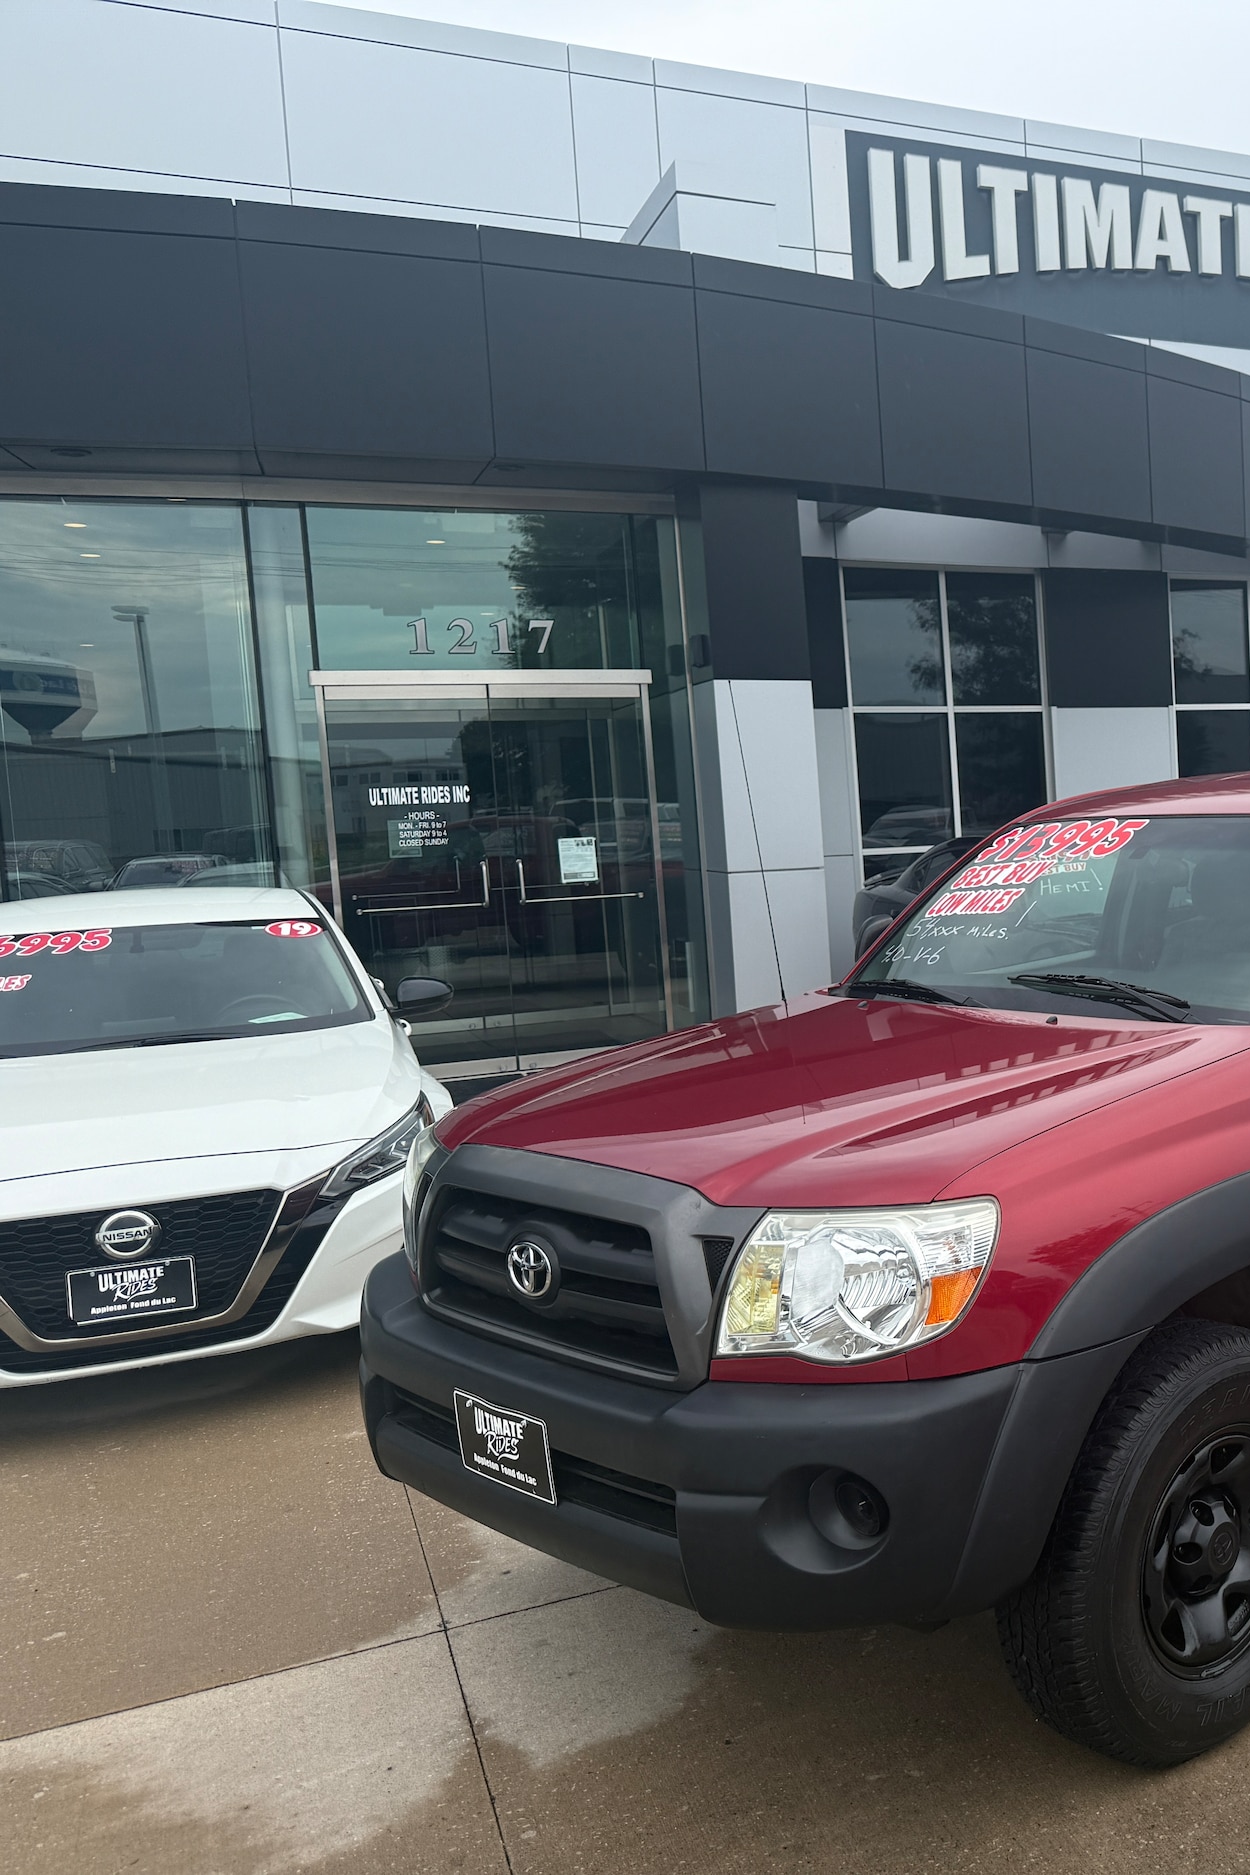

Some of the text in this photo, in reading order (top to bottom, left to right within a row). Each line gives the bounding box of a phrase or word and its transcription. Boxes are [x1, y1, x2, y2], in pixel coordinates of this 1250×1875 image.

[407, 618, 554, 654] 1217
[369, 785, 470, 806] ULTIMATE RIDES INC
[408, 811, 435, 820] HOURS
[399, 830, 431, 838] SATURDAY
[399, 838, 449, 847] CLOSED SUNDAY
[974, 818, 1150, 863] $13995
[951, 860, 1055, 890] BEST BUY
[1063, 862, 1087, 873] BUY
[925, 888, 1025, 918] LOW MILES
[276, 921, 306, 937] 19
[102, 1226, 154, 1242] NISSAN
[98, 1266, 164, 1292] ULTIMATE
[91, 1303, 127, 1315] Appleton
[130, 1300, 150, 1309] Fond
[151, 1298, 161, 1306] du
[474, 1406, 524, 1440] ULTIMATE
